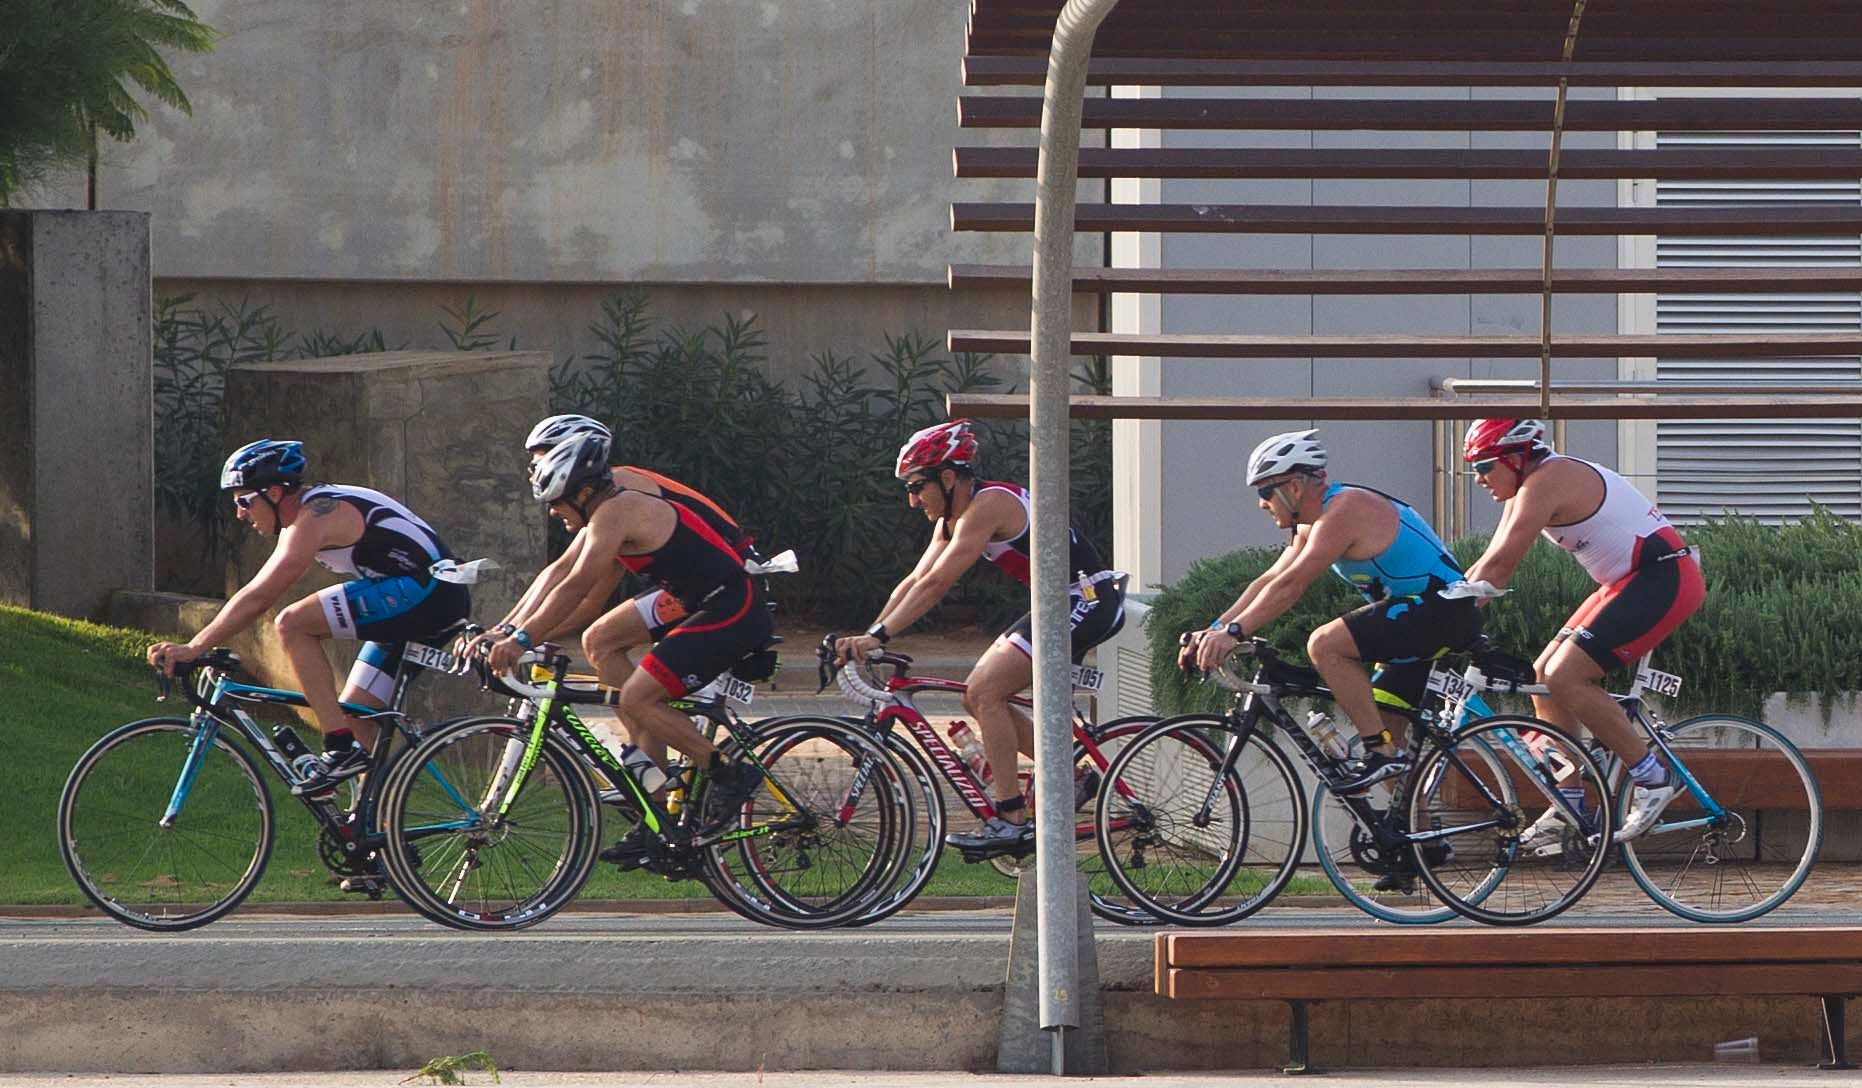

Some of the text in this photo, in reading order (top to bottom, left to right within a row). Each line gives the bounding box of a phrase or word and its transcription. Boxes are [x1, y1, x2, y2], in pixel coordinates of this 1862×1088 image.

[723, 677, 752, 702] 1032
[1078, 667, 1104, 689] 1051
[1441, 675, 1474, 700] 1347
[1650, 673, 1680, 695] 1125
[910, 721, 988, 808] SPECIALIZED
